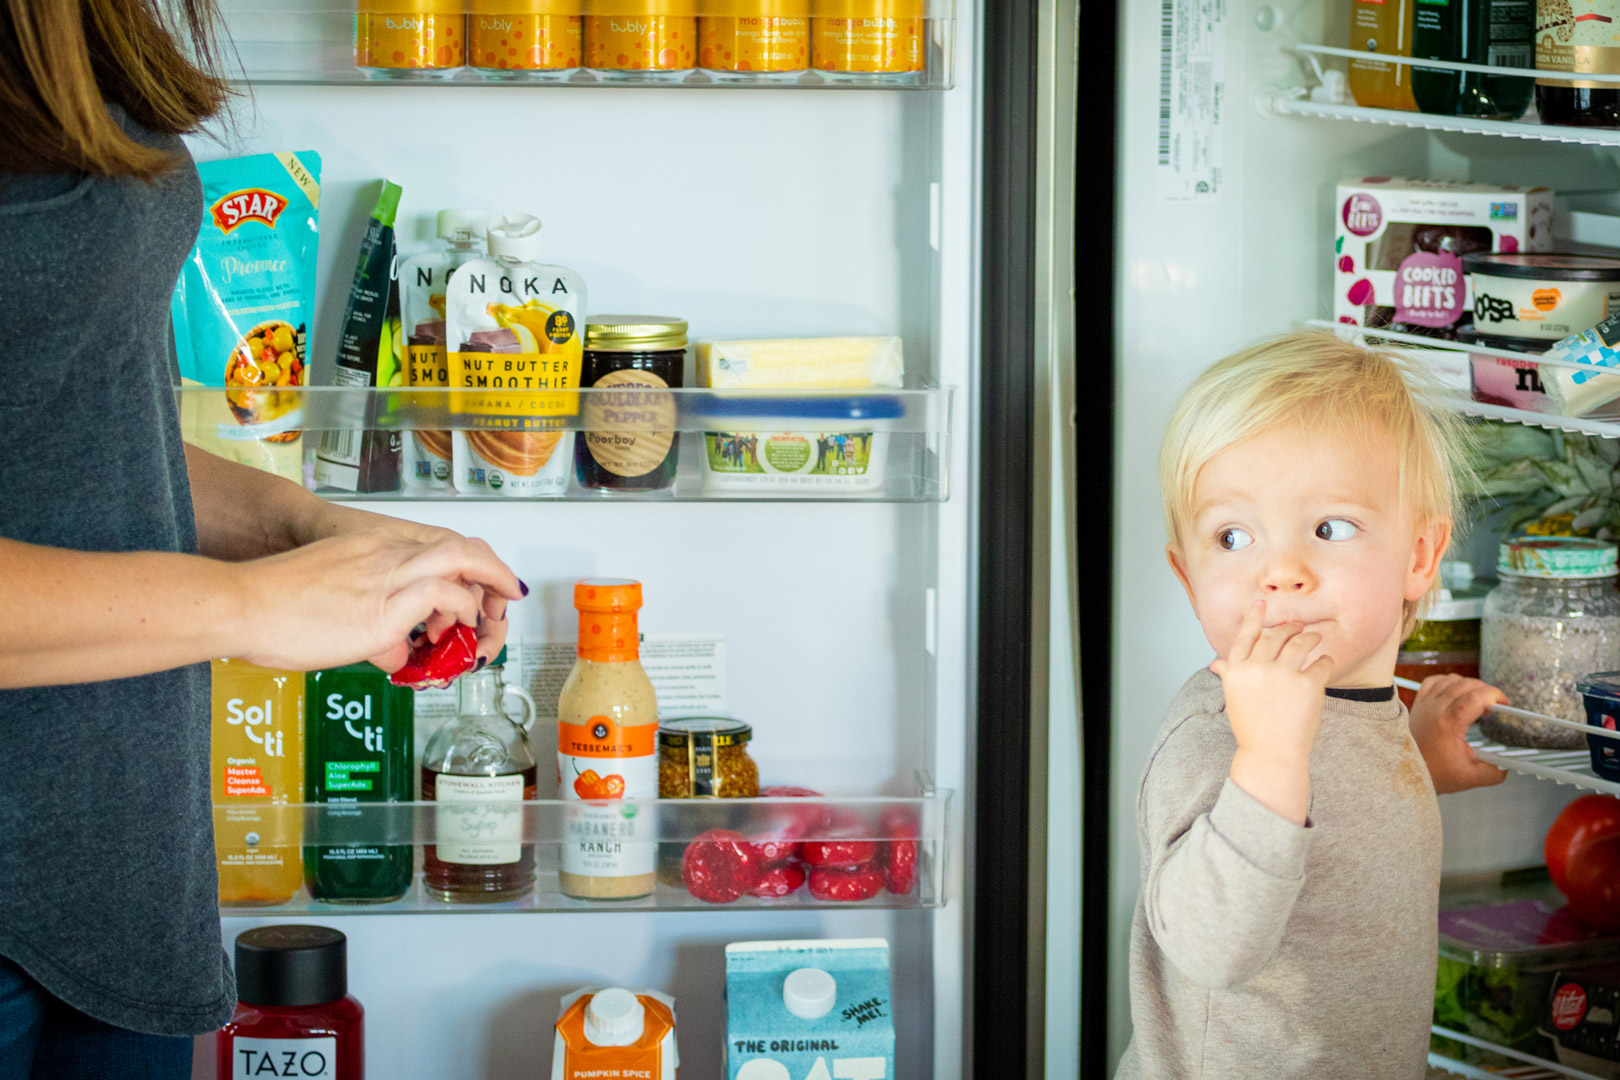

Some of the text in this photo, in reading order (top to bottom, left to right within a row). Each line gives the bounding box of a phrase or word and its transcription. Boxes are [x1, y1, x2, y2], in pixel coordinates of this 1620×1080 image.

[287, 158, 311, 186] NEW
[222, 193, 278, 225] STAR
[470, 273, 569, 295] NOKA
[1402, 284, 1456, 309] BEETS
[410, 352, 438, 364] NUT
[463, 359, 569, 373] NUT BUTTER
[464, 374, 568, 388] SMOOTHIE
[588, 432, 636, 446] Poorboy
[226, 698, 272, 725] Sol
[325, 693, 372, 720] Sol
[571, 742, 633, 753] TESSEMAE'S
[227, 757, 256, 766] Organic
[328, 763, 376, 772] Chlorophyll
[227, 767, 257, 776] Master
[227, 776, 261, 785] Cleanse
[841, 997, 883, 1021] SHAKE
[857, 1008, 884, 1027] ME!
[734, 1039, 840, 1053] THE ORIGINAL
[239, 1049, 327, 1077] TAZO
[573, 1069, 652, 1079] PUMPKIN SPICE
